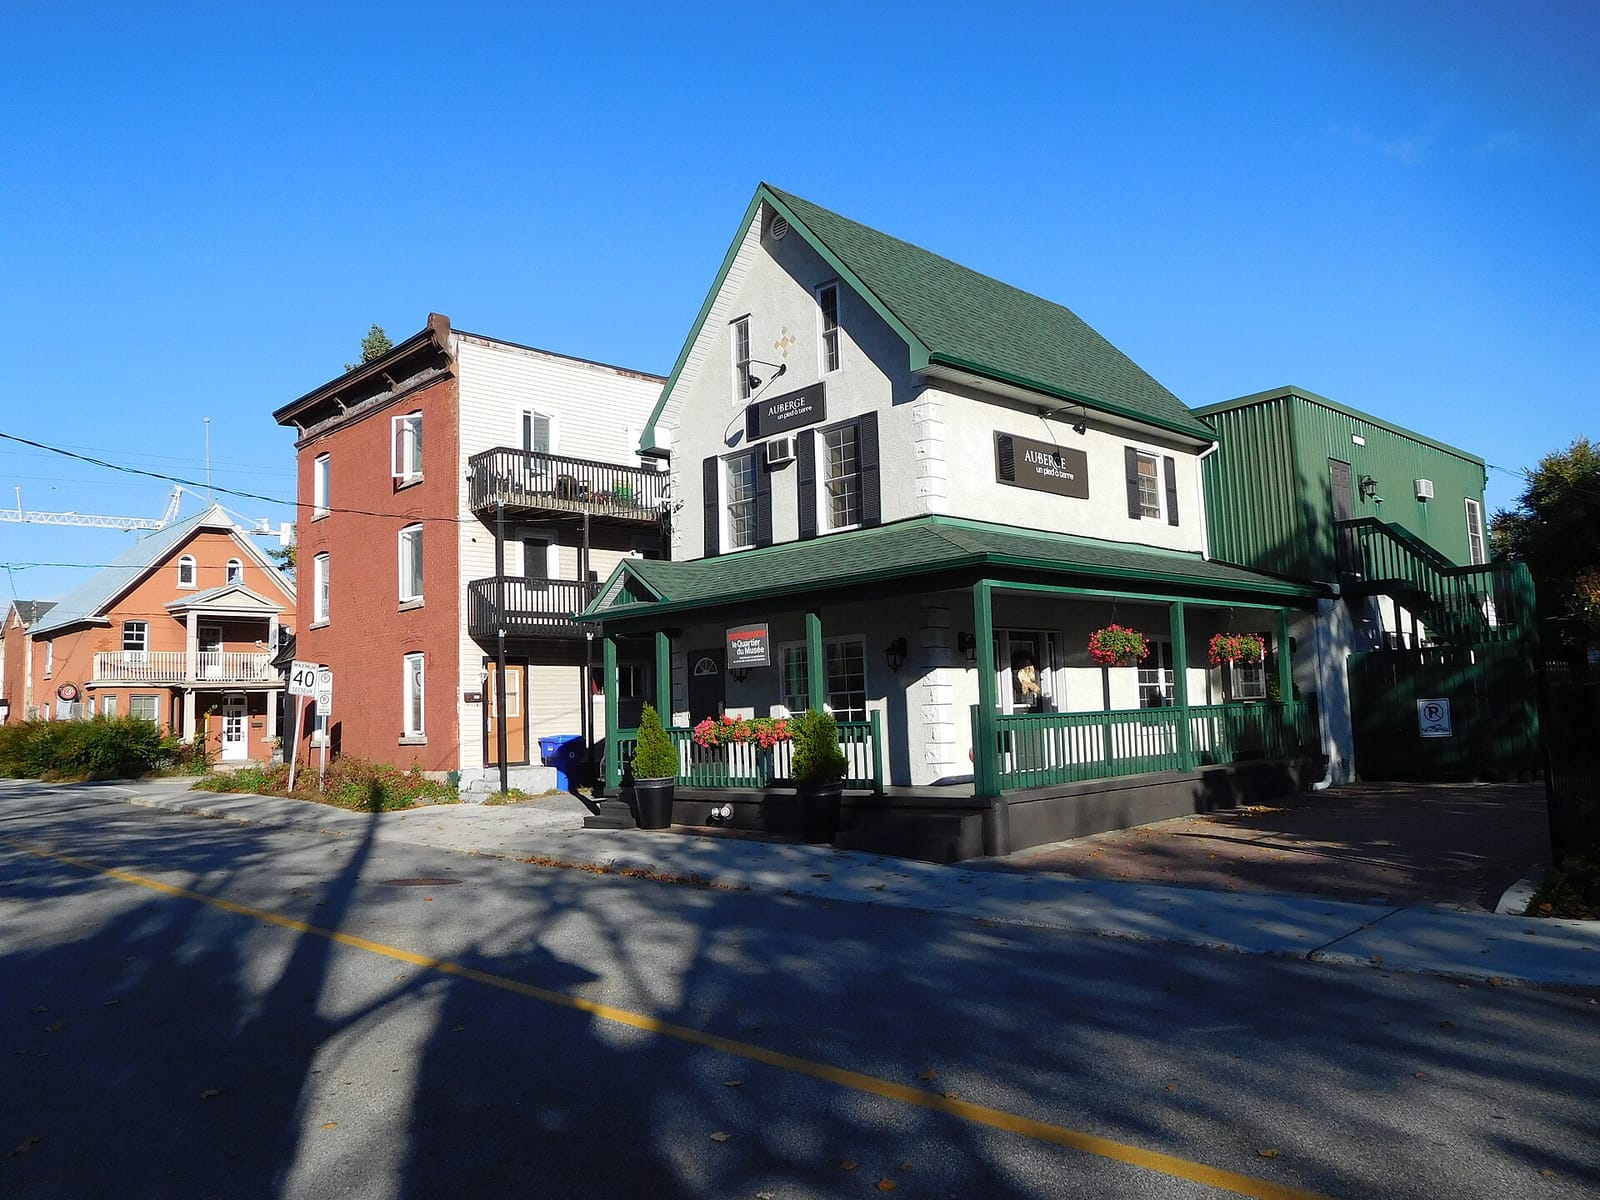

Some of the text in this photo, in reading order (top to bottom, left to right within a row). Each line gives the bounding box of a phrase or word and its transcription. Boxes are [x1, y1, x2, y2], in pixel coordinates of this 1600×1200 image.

[768, 397, 806, 416] AUBERGE
[783, 409, 795, 419] pied
[798, 405, 813, 414] terre
[1043, 467, 1055, 477] pied
[1059, 471, 1074, 480] terre
[731, 638, 760, 648] le Quartier
[744, 646, 765, 655] Musée
[293, 670, 315, 687] 40
